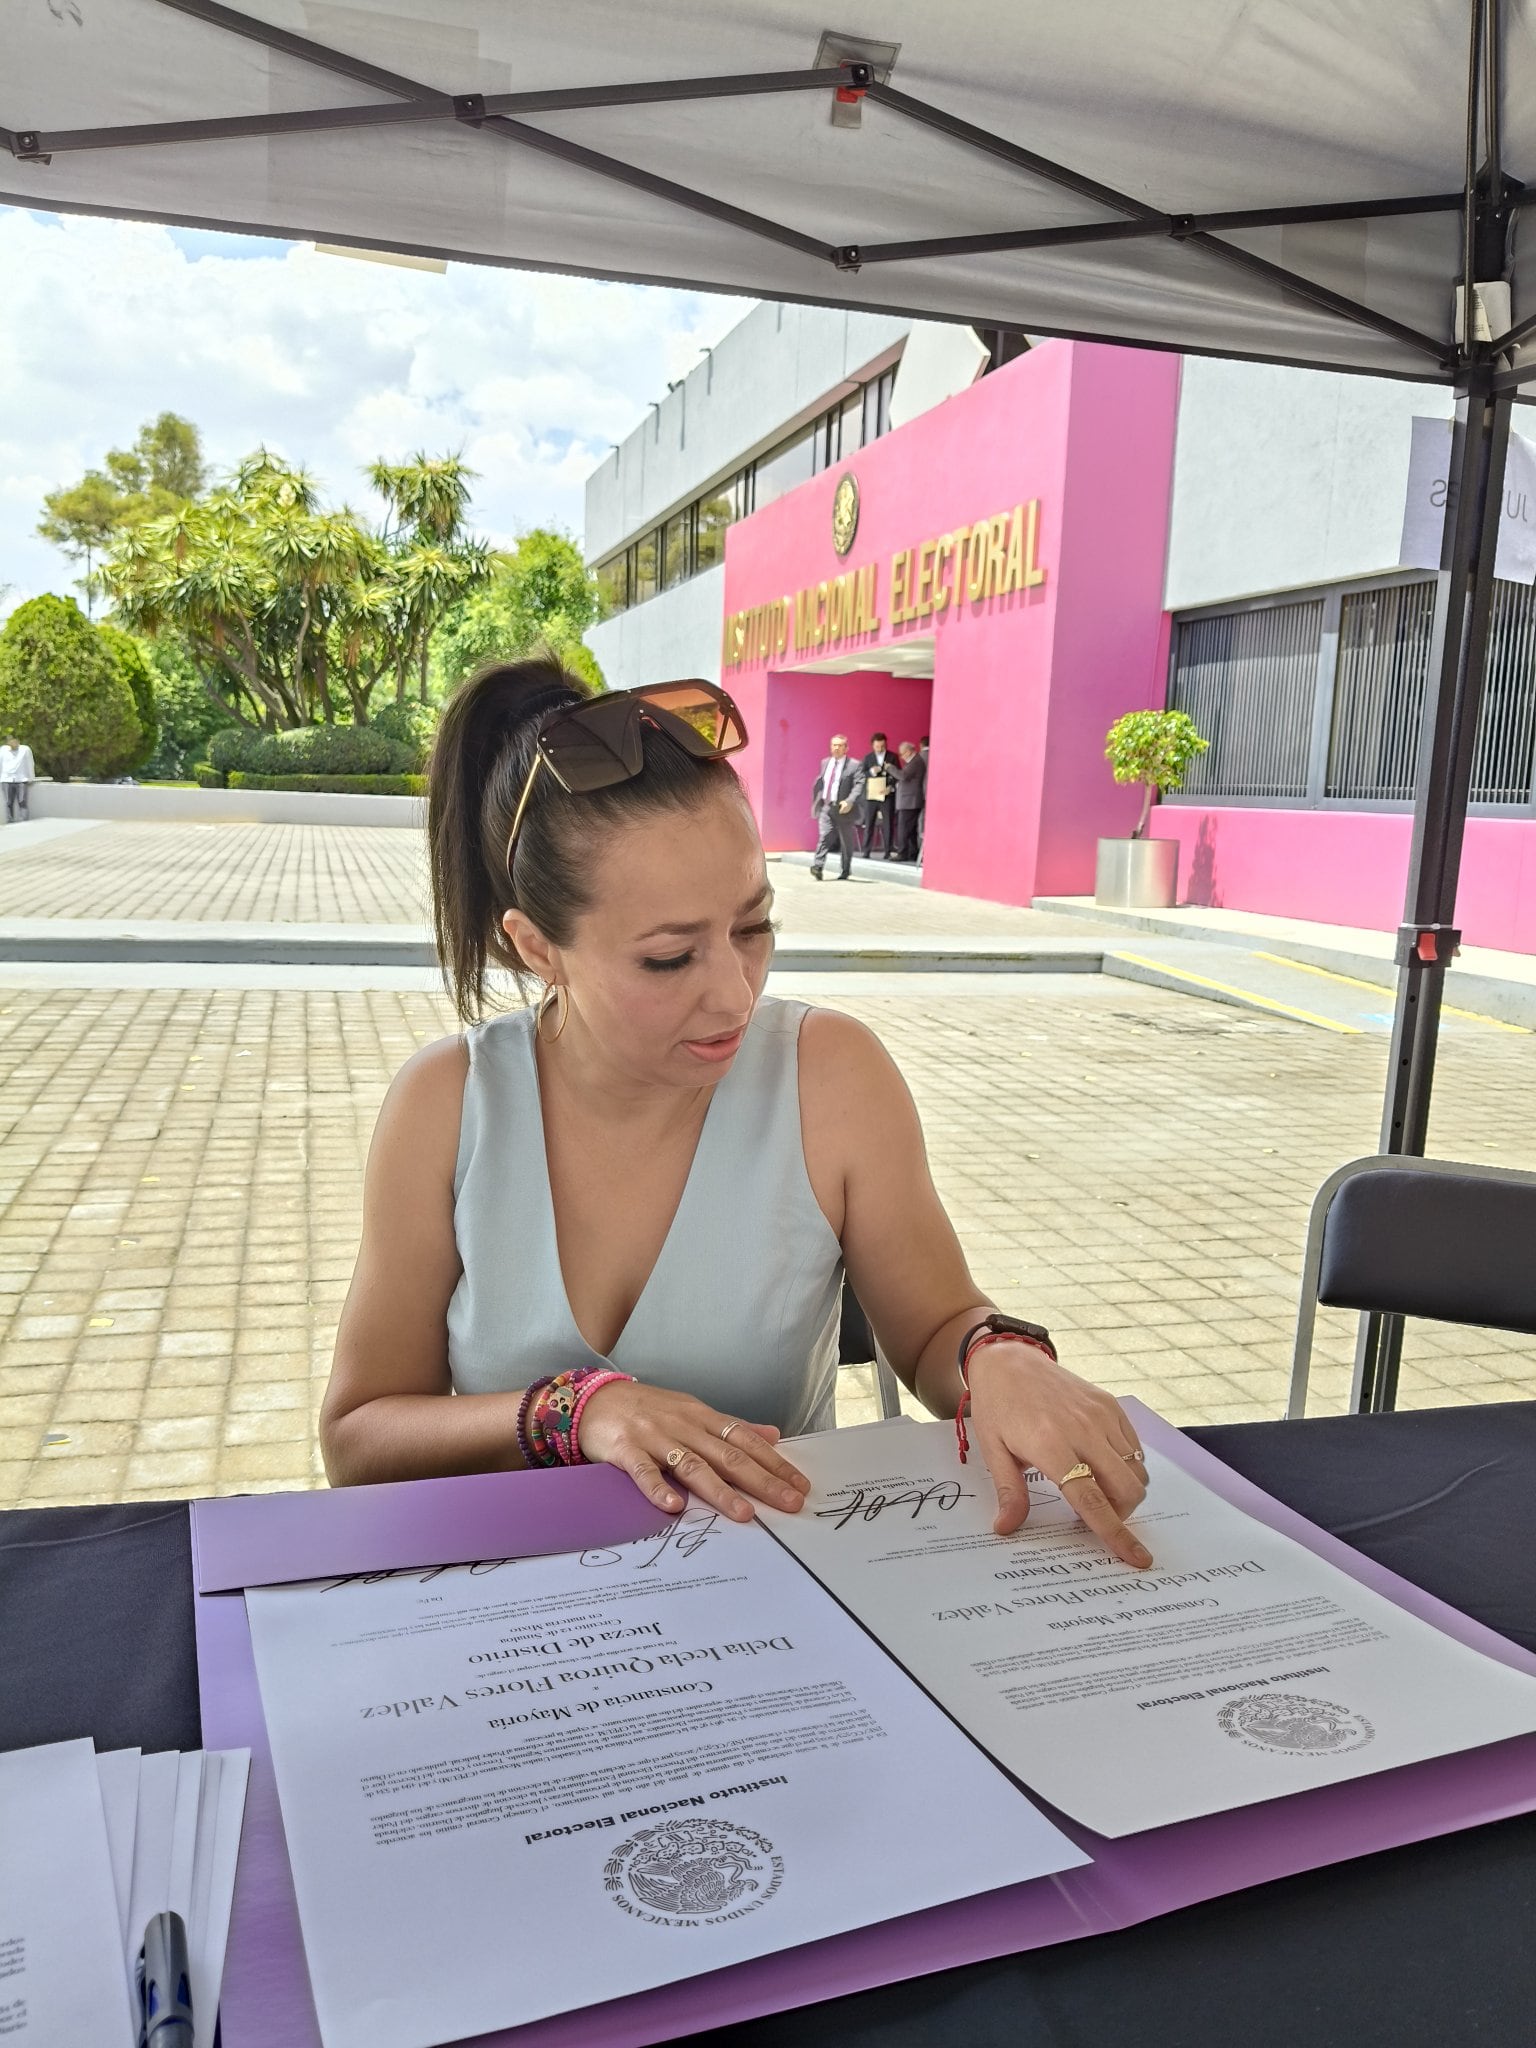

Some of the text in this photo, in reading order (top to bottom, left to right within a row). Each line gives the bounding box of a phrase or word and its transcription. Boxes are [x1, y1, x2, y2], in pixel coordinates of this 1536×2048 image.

[725, 498, 1046, 667] INSTITUTO NACIONAL ELECTORAL
[994, 1555, 1128, 1580] eza de Distrito
[1206, 1560, 1266, 1578] Delia
[1080, 1578, 1159, 1597] Quiroa
[1155, 1572, 1211, 1587] Icela
[1011, 1591, 1085, 1608] Flores
[545, 1616, 586, 1627] materia
[932, 1603, 1014, 1621] Valdez
[1047, 1599, 1219, 1631] Constancia de Mayoría
[510, 1624, 544, 1632] Mixto
[574, 1619, 622, 1630] Circuito
[468, 1622, 662, 1663] Jueza de Distrito
[500, 1633, 542, 1643] Sinaloa
[360, 1637, 794, 1718] Delia Icela Quiroa Flores Valdez
[603, 1681, 713, 1707] Constancia
[1136, 1666, 1331, 1711] Instituto Nacional Electoral
[577, 1701, 600, 1713] de
[488, 1706, 572, 1730] Mayoría
[524, 1775, 788, 1845] Instituto Nacional Electoral
[611, 1855, 785, 1928] ESTADOS UNIDOS MEXICANOS
